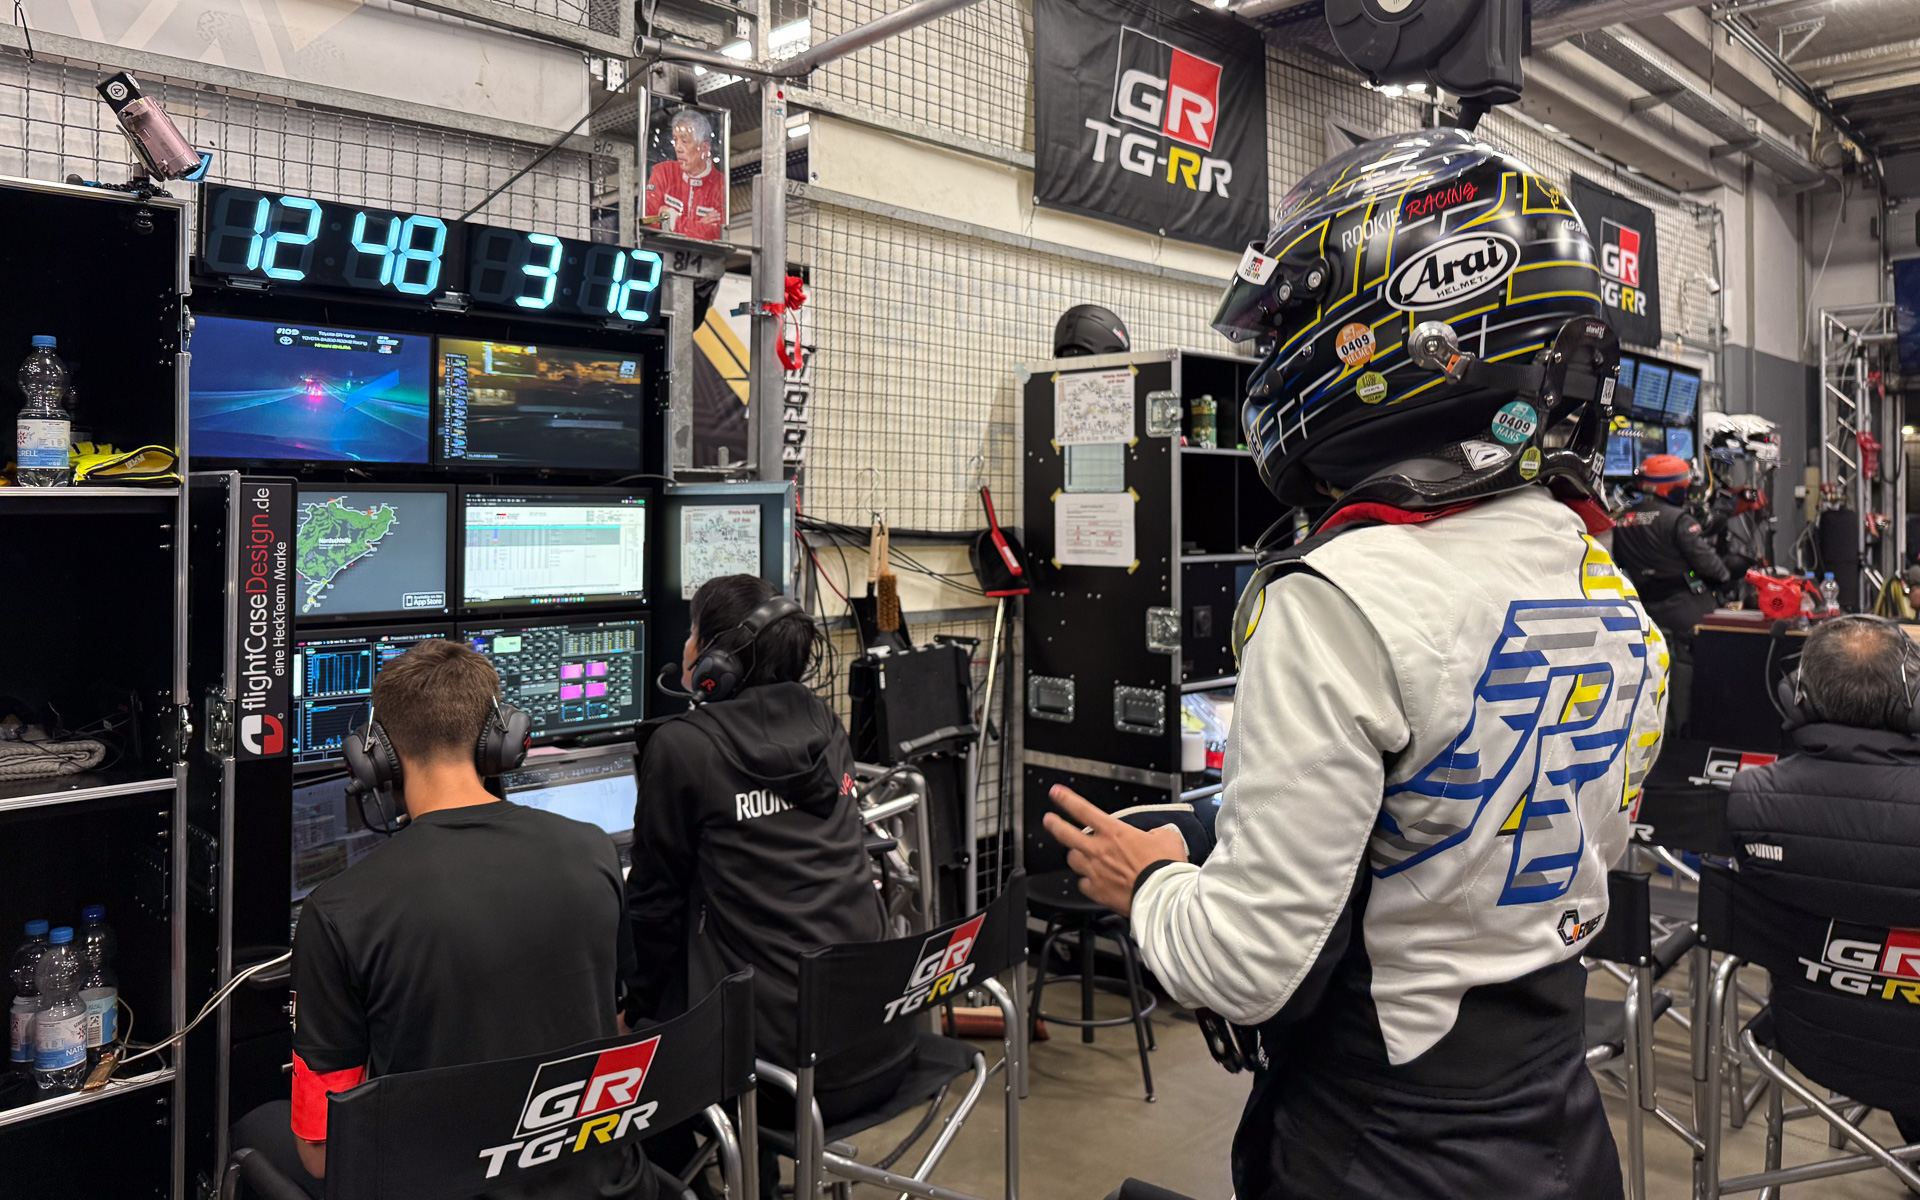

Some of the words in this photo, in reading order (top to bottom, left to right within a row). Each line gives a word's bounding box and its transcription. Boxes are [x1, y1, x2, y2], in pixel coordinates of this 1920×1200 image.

[1117, 68, 1214, 144] GR
[1084, 118, 1233, 199] TG-RR
[1342, 206, 1403, 252] ROOKIE
[1405, 182, 1478, 220] RACING
[245, 196, 323, 281] 12
[351, 210, 447, 296] 48
[673, 251, 703, 273] 8/1
[1401, 237, 1506, 304] Arai
[1602, 243, 1638, 284] GR
[515, 232, 564, 309] 3
[606, 249, 662, 322] 12
[1436, 276, 1483, 299] HELMET
[1341, 334, 1370, 356] 0409
[1496, 426, 1521, 442] HANS
[1499, 413, 1531, 434] 0409
[273, 541, 287, 580] Marke
[242, 487, 274, 710] flightCaseDesign.de
[272, 583, 286, 647] HeckTeam
[413, 599, 427, 607] App
[273, 650, 285, 677] eine
[1745, 843, 1783, 861] PUMA
[910, 937, 972, 988] GR
[883, 963, 975, 1024] TG-RR
[523, 1067, 643, 1130] GR
[478, 1100, 659, 1179] TG-RR
